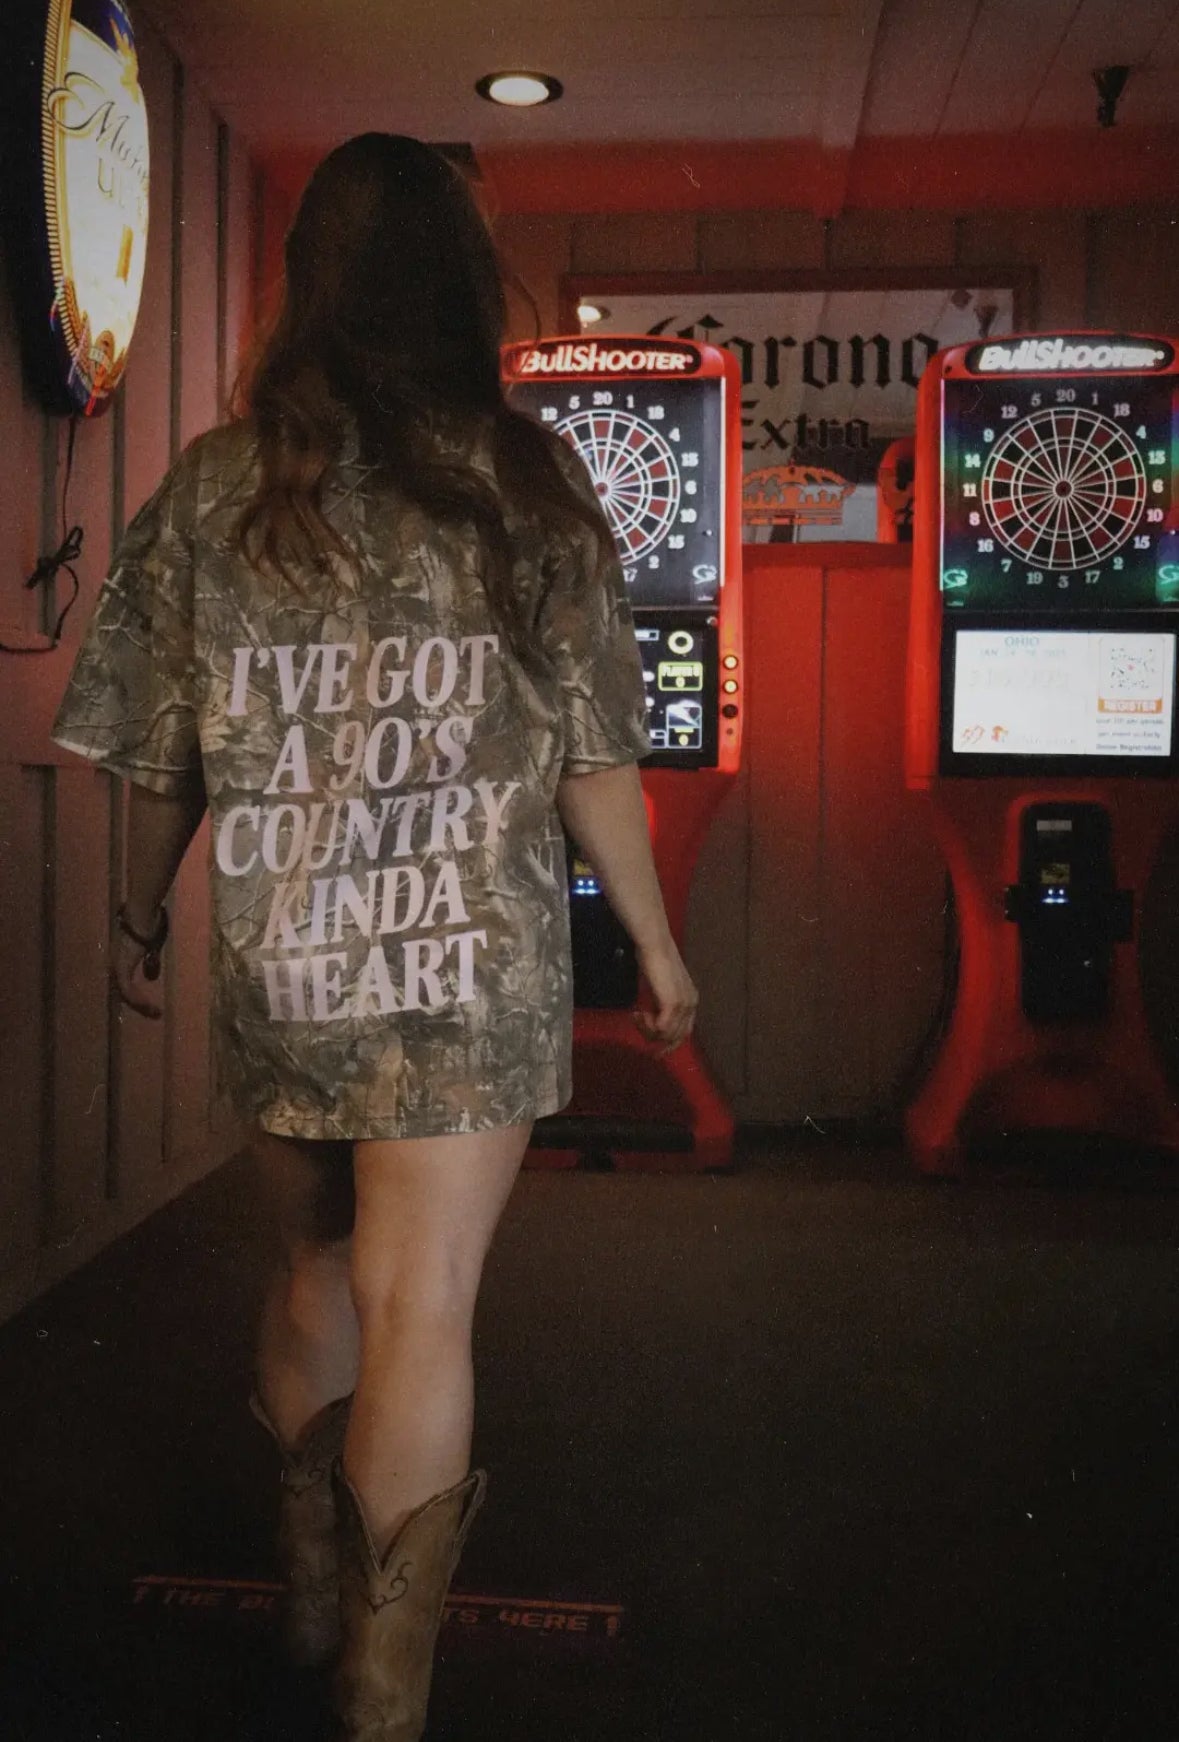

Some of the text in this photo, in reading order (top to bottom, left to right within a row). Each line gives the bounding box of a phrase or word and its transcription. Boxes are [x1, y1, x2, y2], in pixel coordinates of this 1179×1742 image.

[569, 395, 580, 409] 5
[593, 392, 612, 405] 20
[627, 395, 634, 408] 1
[1031, 393, 1041, 406] 5
[1057, 389, 1076, 402] 20
[1092, 392, 1099, 405] 1
[541, 407, 557, 421] 12
[1001, 405, 1017, 419] 12
[1114, 403, 1130, 417] 18
[669, 428, 680, 441] 4
[983, 429, 994, 442] 9
[1136, 425, 1147, 439] 4
[964, 454, 980, 468] 14
[685, 480, 697, 494] 6
[963, 483, 977, 497] 11
[1152, 479, 1163, 493] 6
[680, 509, 697, 523] 10
[969, 512, 980, 526] 8
[1147, 508, 1163, 522] 10
[668, 535, 684, 549] 15
[977, 539, 993, 553] 16
[1134, 536, 1150, 549] 15
[649, 555, 659, 569] 2
[1001, 559, 1012, 573] 7
[1113, 557, 1124, 570] 2
[1026, 571, 1043, 584] 19
[1059, 575, 1069, 588] 3
[1085, 570, 1100, 583] 17
[226, 634, 499, 717] I'VE GOT
[263, 716, 475, 795] A 90'S
[216, 781, 522, 877] COUNTRY
[260, 861, 472, 950] KINDA
[263, 930, 489, 1022] HEART
